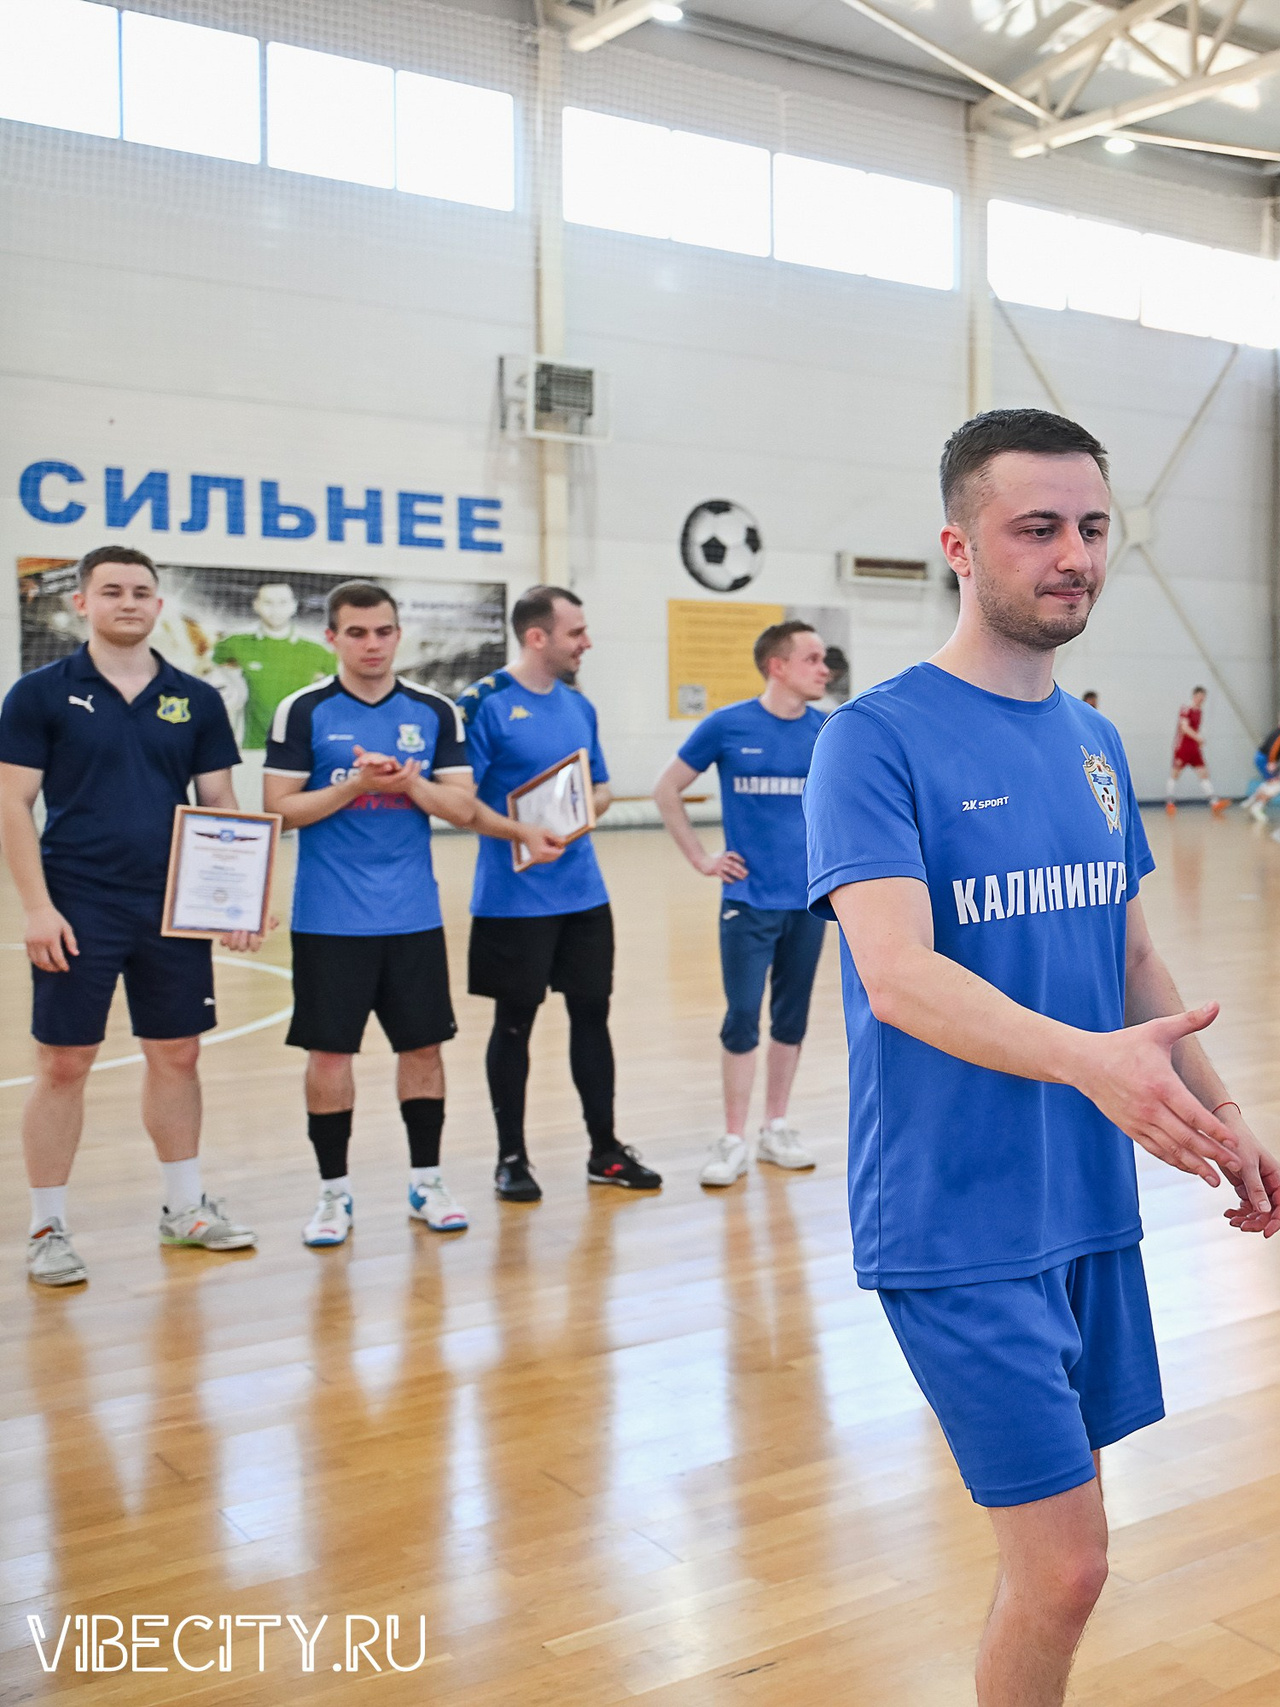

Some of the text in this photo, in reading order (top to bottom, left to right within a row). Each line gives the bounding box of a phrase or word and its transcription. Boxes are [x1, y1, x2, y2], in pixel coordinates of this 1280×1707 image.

[18, 460, 505, 553] СИЛЬНЕЕ
[961, 795, 1010, 812] 2K SPORT
